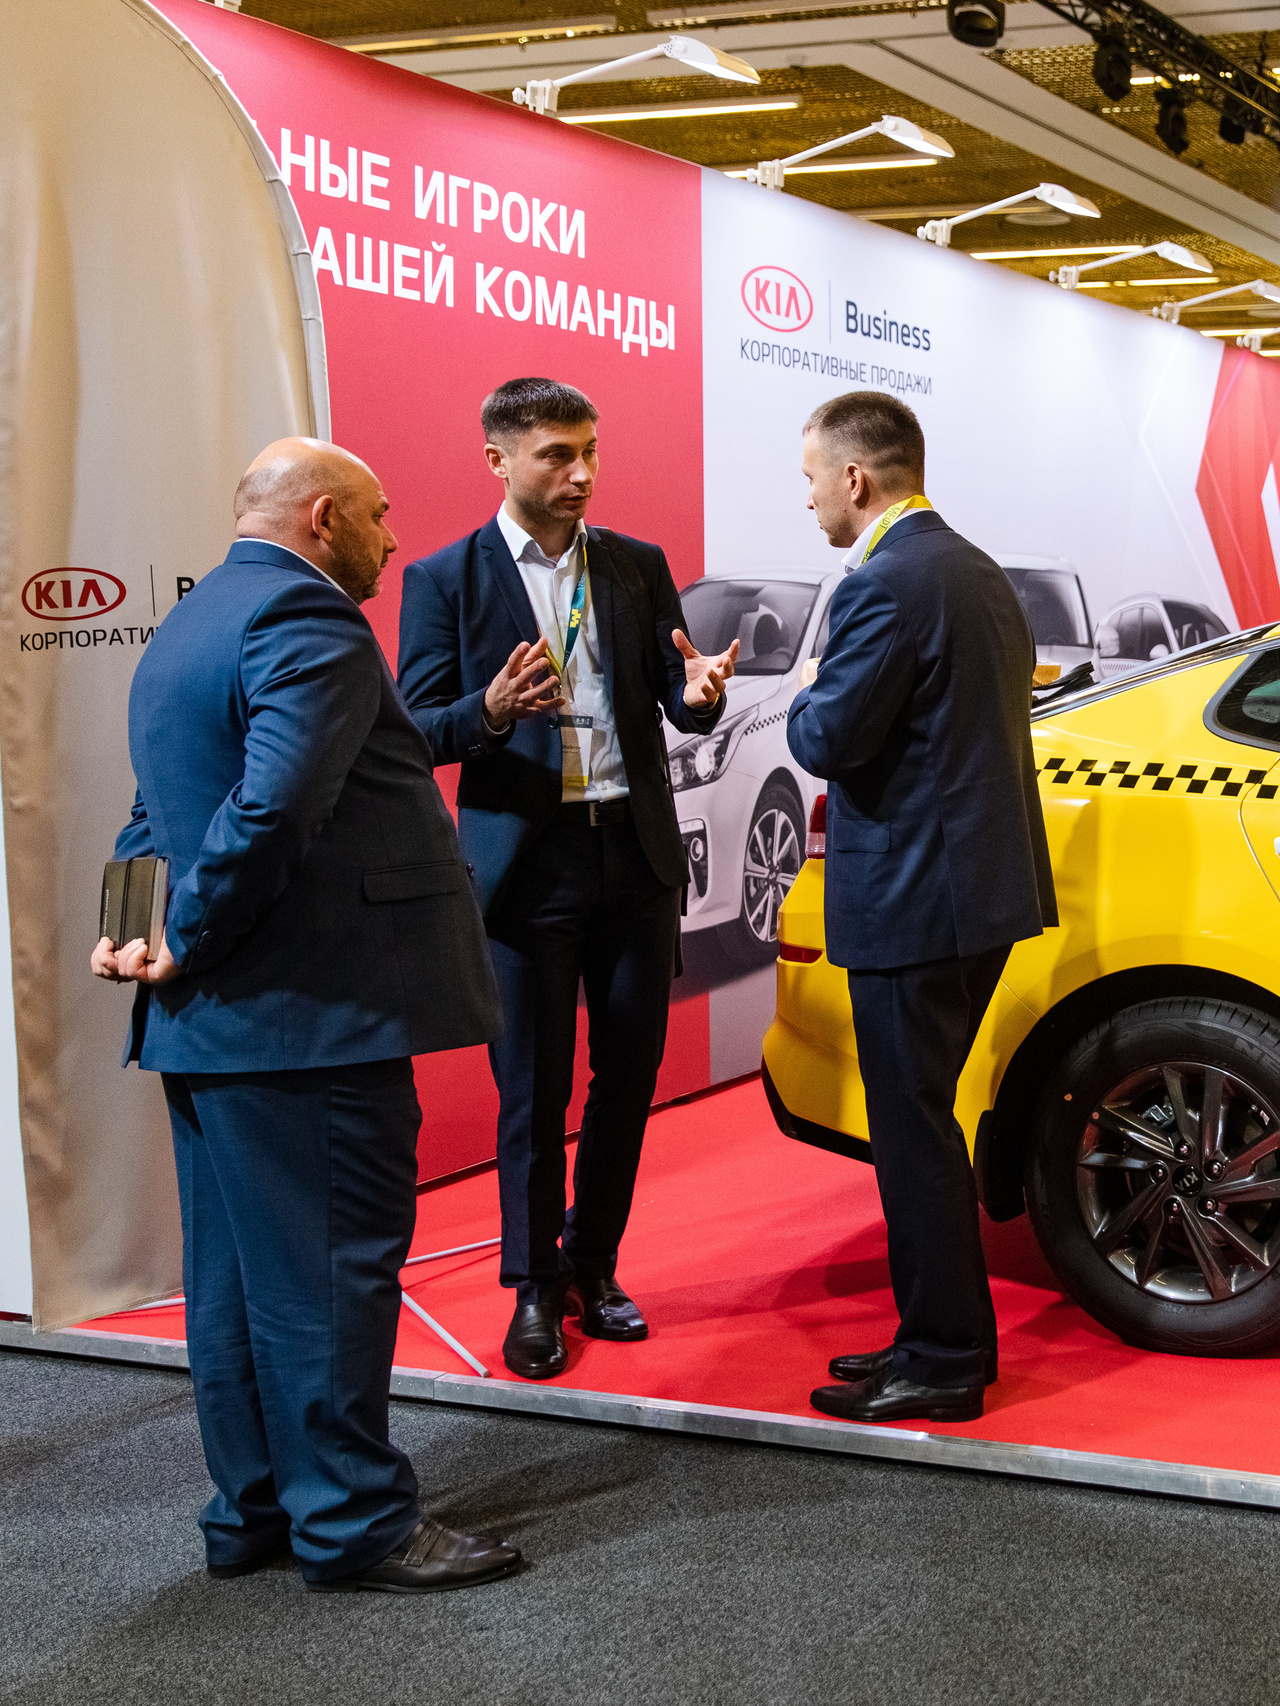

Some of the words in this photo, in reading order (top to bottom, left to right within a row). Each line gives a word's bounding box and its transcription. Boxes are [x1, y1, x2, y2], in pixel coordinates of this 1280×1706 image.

[251, 119, 391, 209] НЫЕ
[414, 165, 586, 258] ИГРОКИ
[312, 226, 455, 307] АШЕЙ
[475, 261, 676, 357] КОМАНДЫ
[754, 276, 802, 321] KIA
[845, 300, 931, 351] Business
[740, 338, 867, 383] КОРПОРАТИВНЫЕ
[870, 365, 932, 395] ПРОДАЖИ
[34, 579, 108, 610] KIA
[20, 627, 159, 652] КОРПОРАТИ
